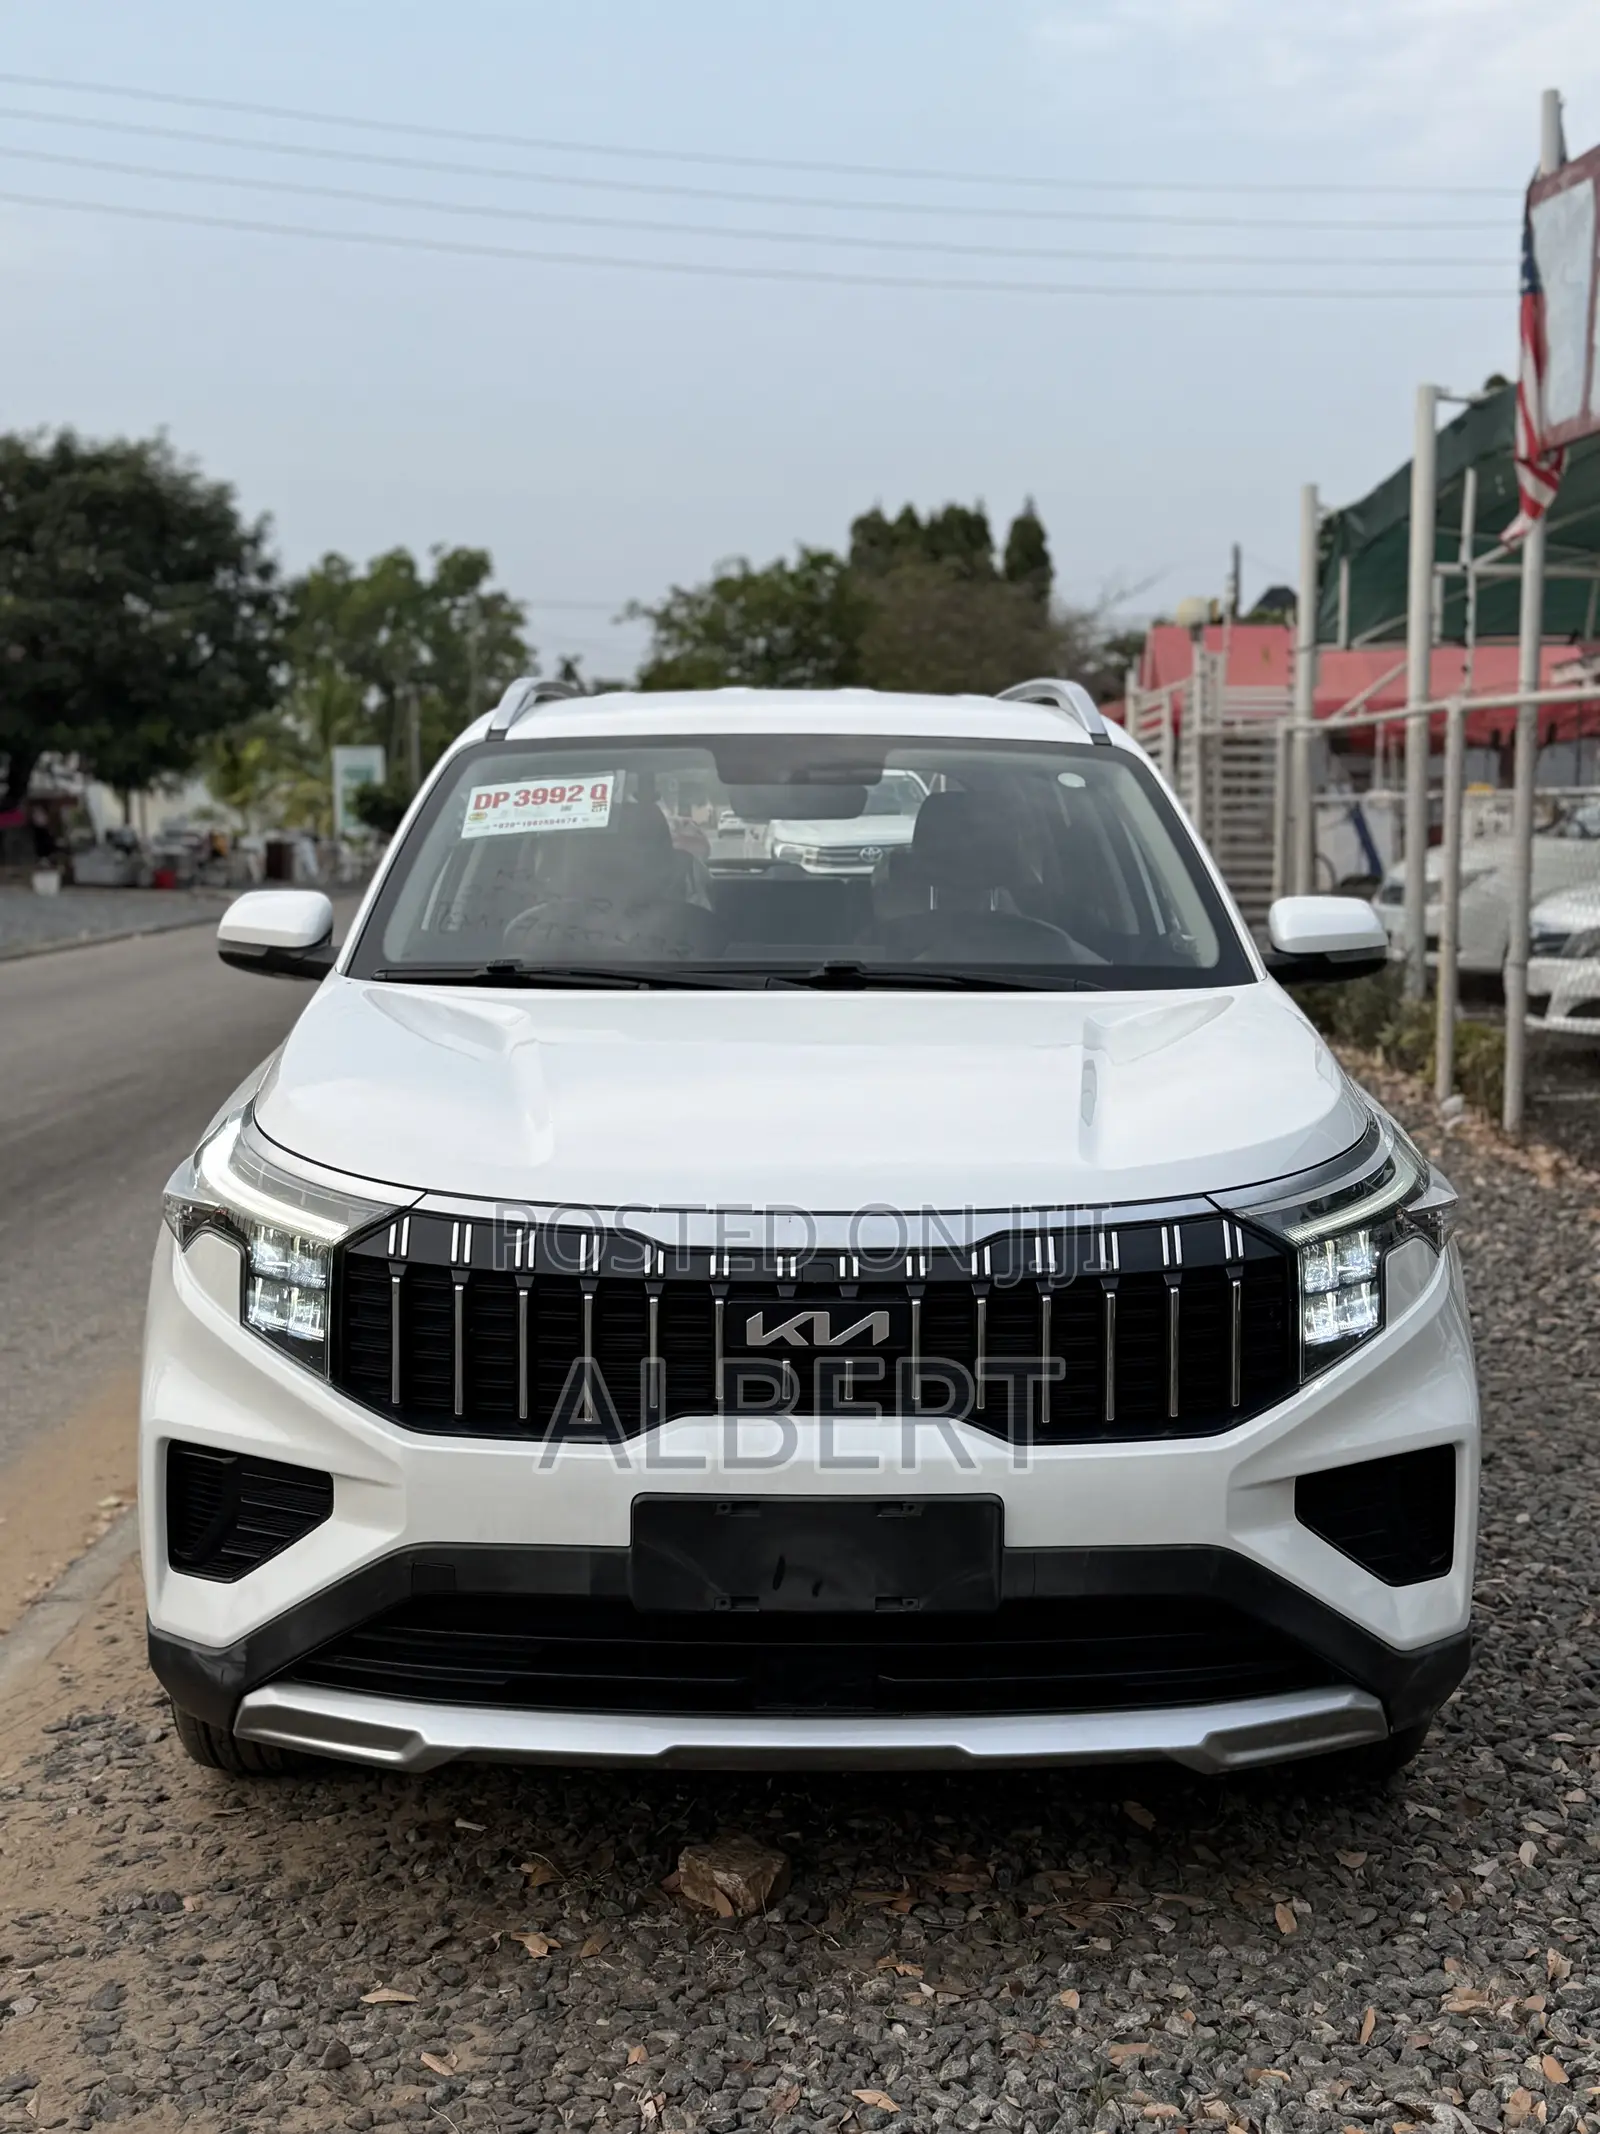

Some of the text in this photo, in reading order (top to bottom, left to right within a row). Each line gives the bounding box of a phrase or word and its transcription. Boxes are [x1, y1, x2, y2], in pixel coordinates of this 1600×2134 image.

[473, 791, 510, 811] DP
[513, 785, 584, 807] 3992
[746, 1310, 890, 1346] KIA
